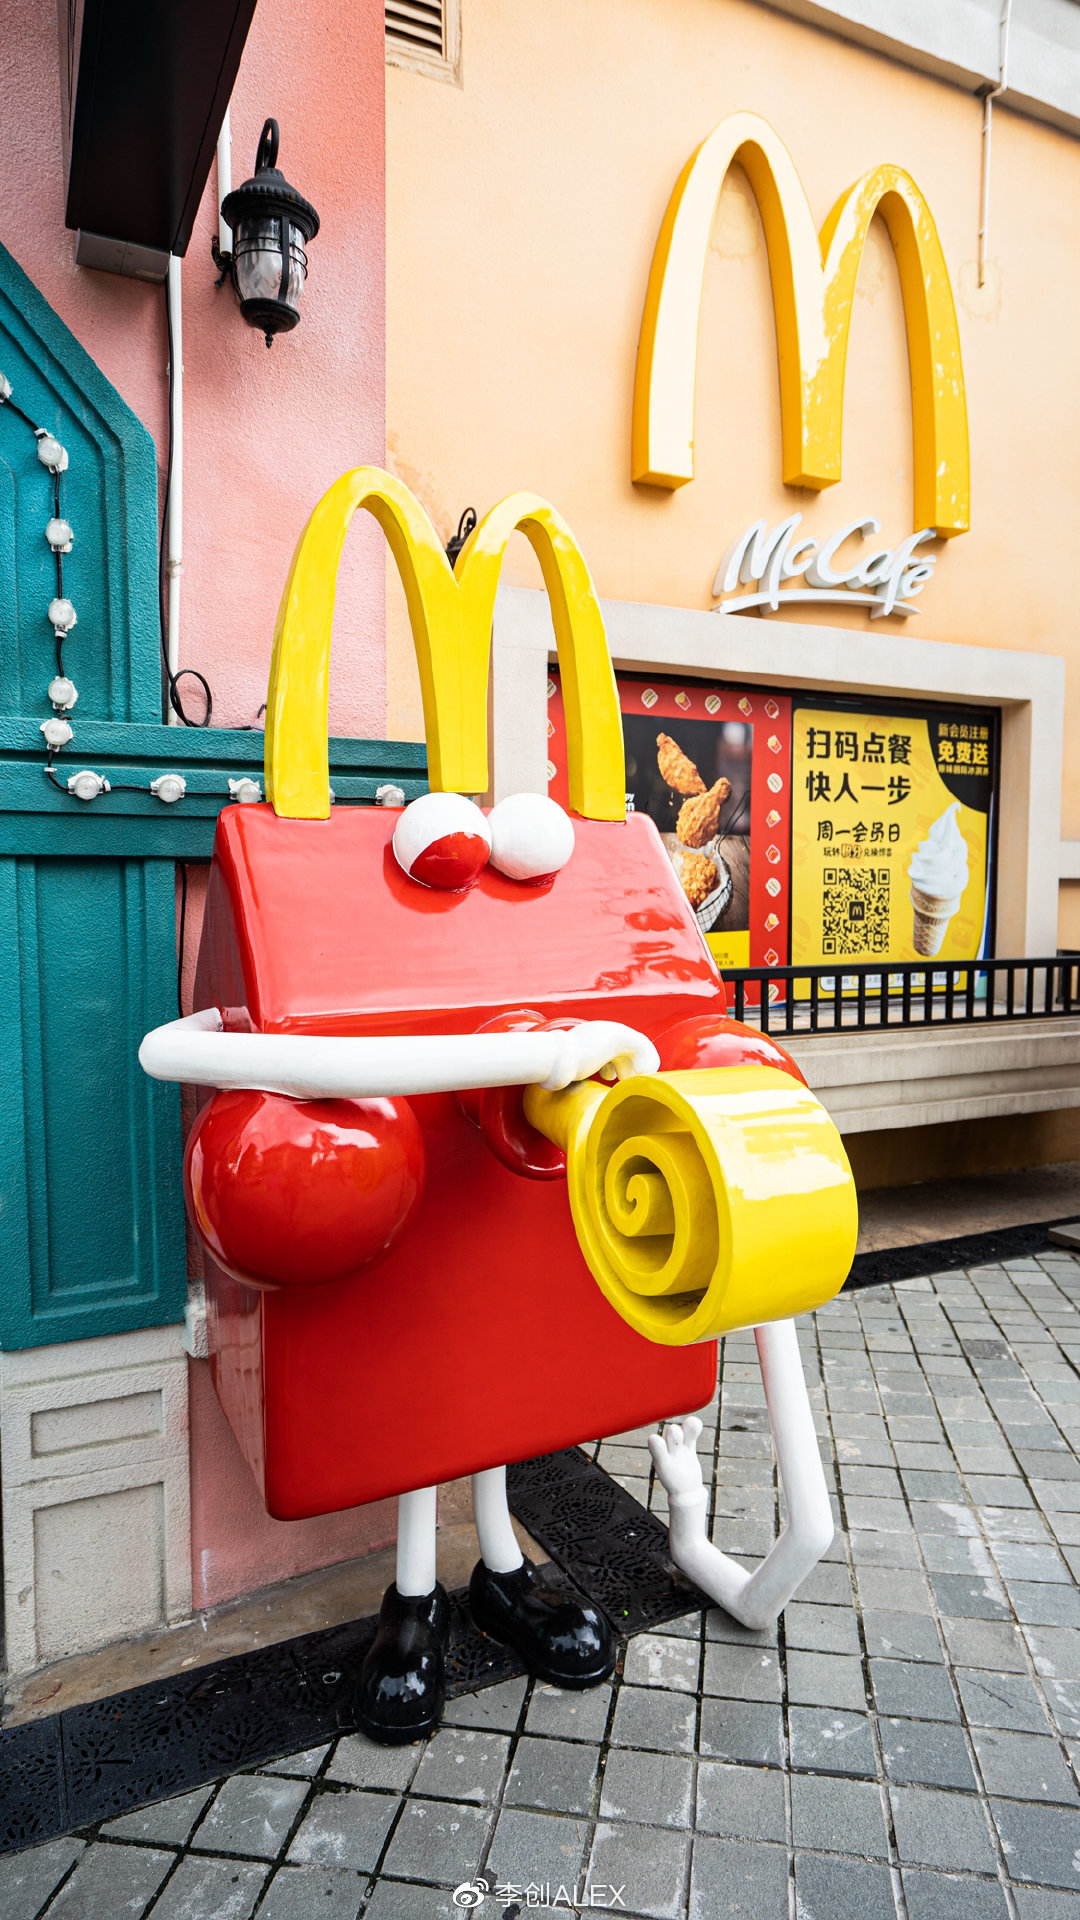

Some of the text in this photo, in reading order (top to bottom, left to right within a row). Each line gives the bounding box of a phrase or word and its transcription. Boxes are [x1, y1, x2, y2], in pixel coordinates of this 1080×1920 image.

[712, 512, 936, 619] McCafé
[806, 727, 912, 765] 扫码点餐
[938, 723, 988, 740] 新会员注册
[938, 740, 988, 765] 免费送
[806, 770, 912, 805] 快人一步
[817, 820, 900, 842] 周一会员日
